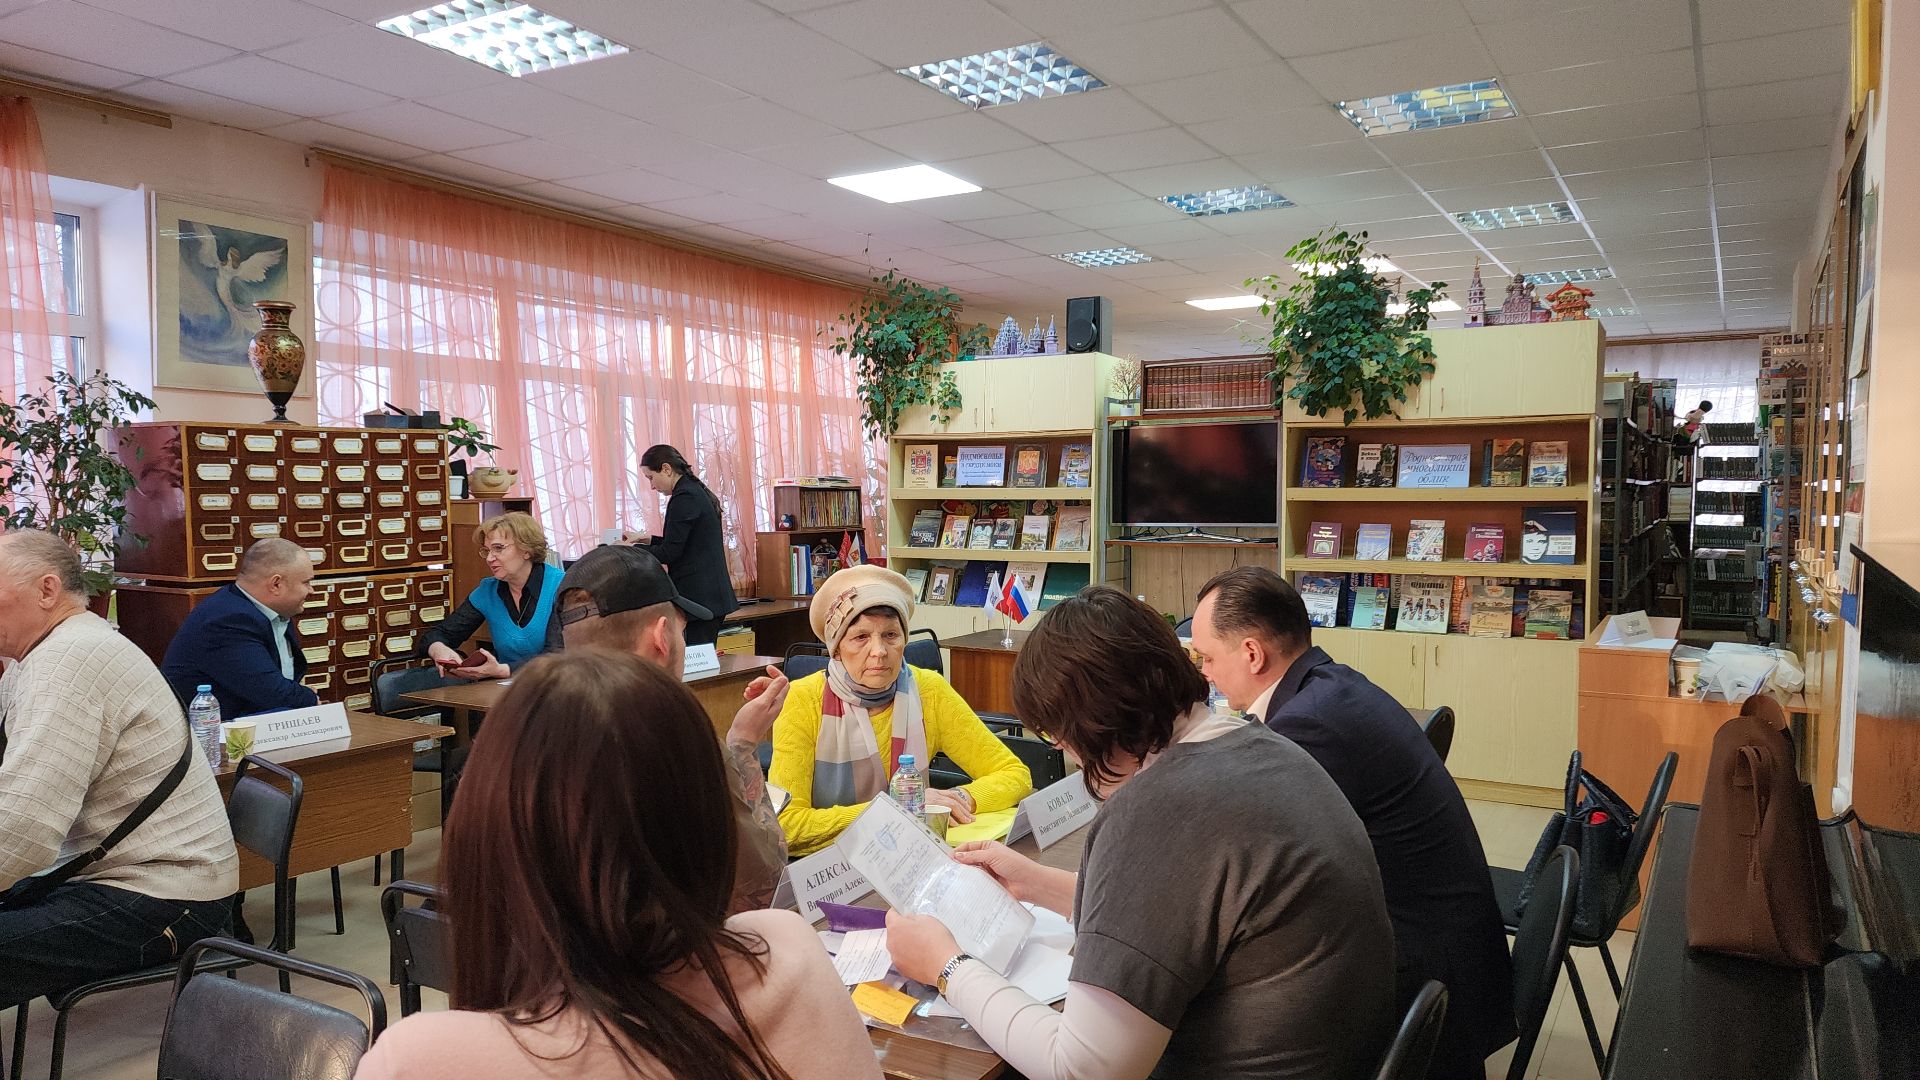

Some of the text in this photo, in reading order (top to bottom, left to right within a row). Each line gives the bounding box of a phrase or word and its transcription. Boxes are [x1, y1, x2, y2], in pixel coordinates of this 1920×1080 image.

[1418, 473, 1450, 483] облик
[268, 716, 321, 731] ГРИШАЕВ
[291, 725, 343, 739] Александрович
[254, 735, 289, 746] лександр
[1046, 791, 1074, 812] КОВАЛЬ
[1038, 815, 1068, 836] Константин
[806, 887, 844, 912] Витория
